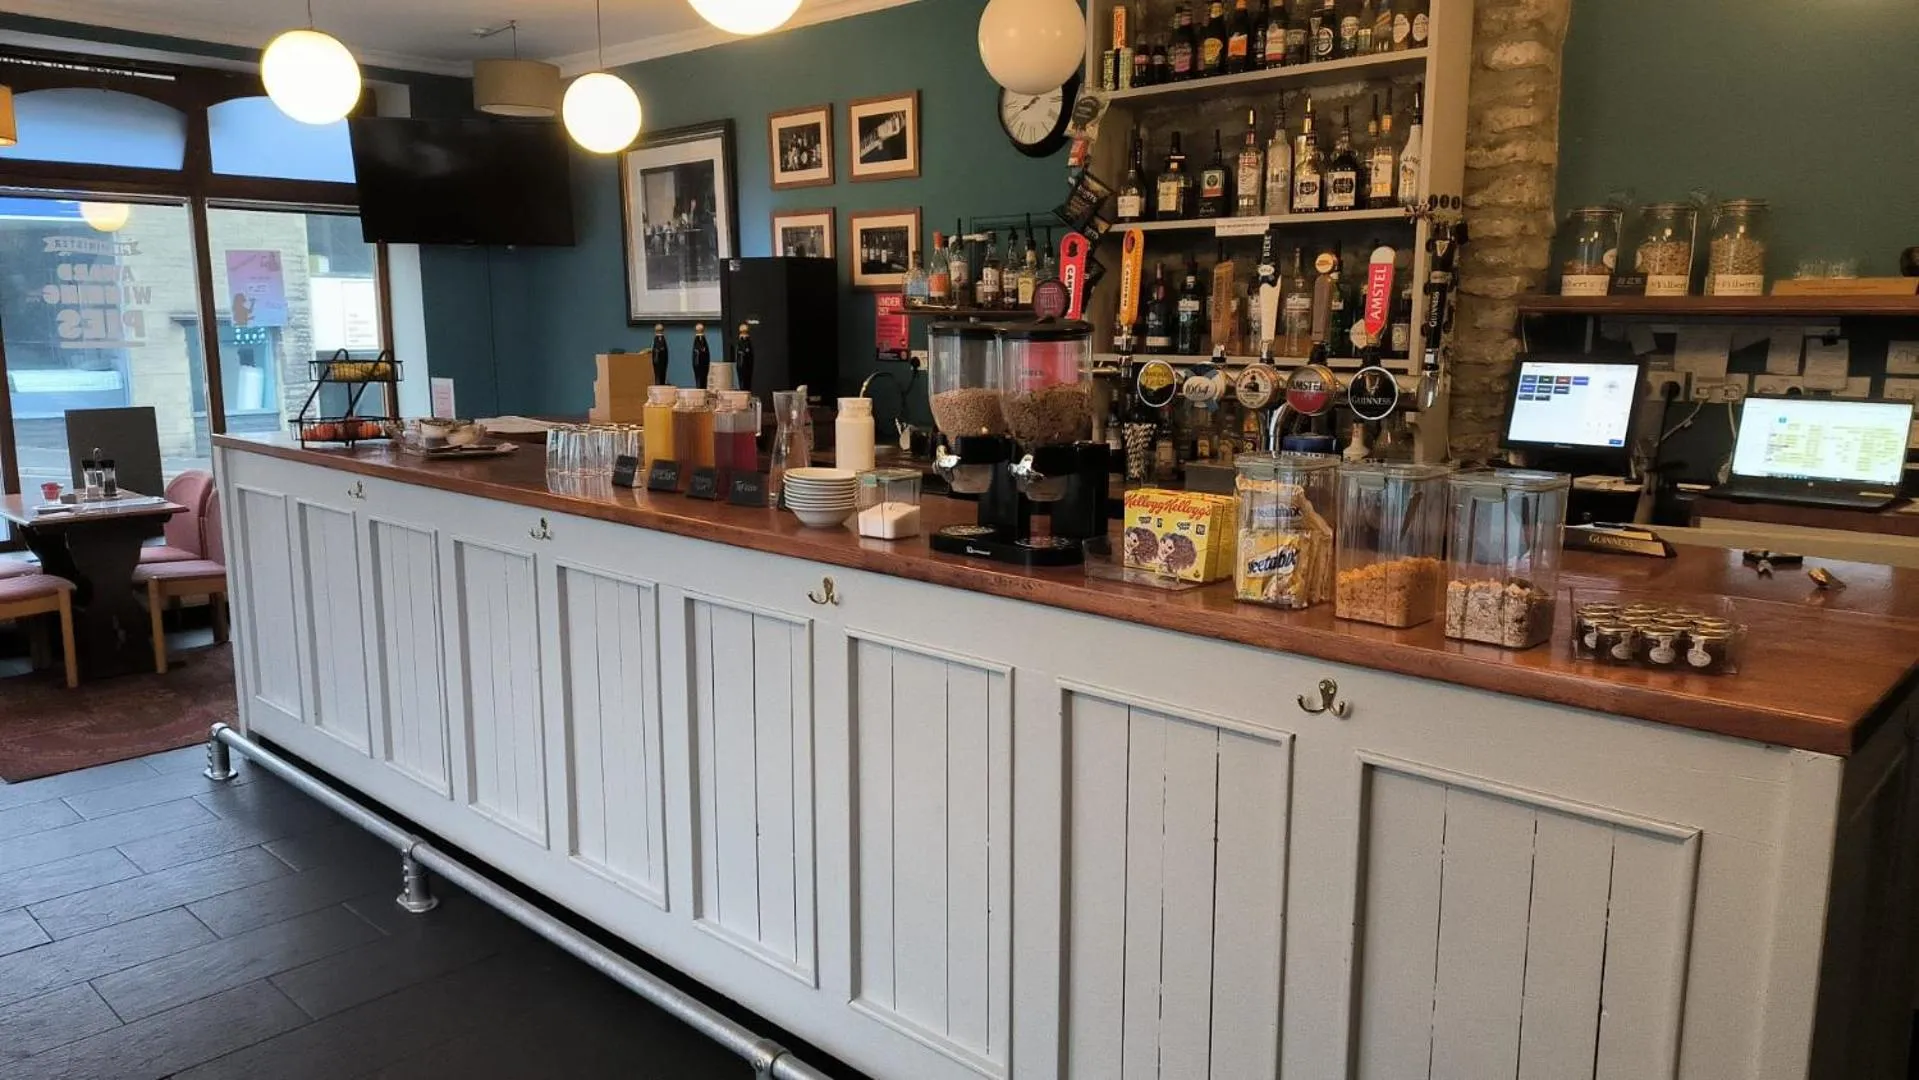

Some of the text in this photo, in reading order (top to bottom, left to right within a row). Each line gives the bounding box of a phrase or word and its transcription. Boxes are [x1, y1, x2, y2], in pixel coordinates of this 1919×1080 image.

[1369, 265, 1388, 320] AMSTEL
[1428, 291, 1441, 328] GUINNESS
[1288, 380, 1324, 392] AMSTEL
[1351, 396, 1392, 406] GUINNESS
[1164, 498, 1211, 520] Kellogg's
[1588, 533, 1634, 548] GUINNESS
